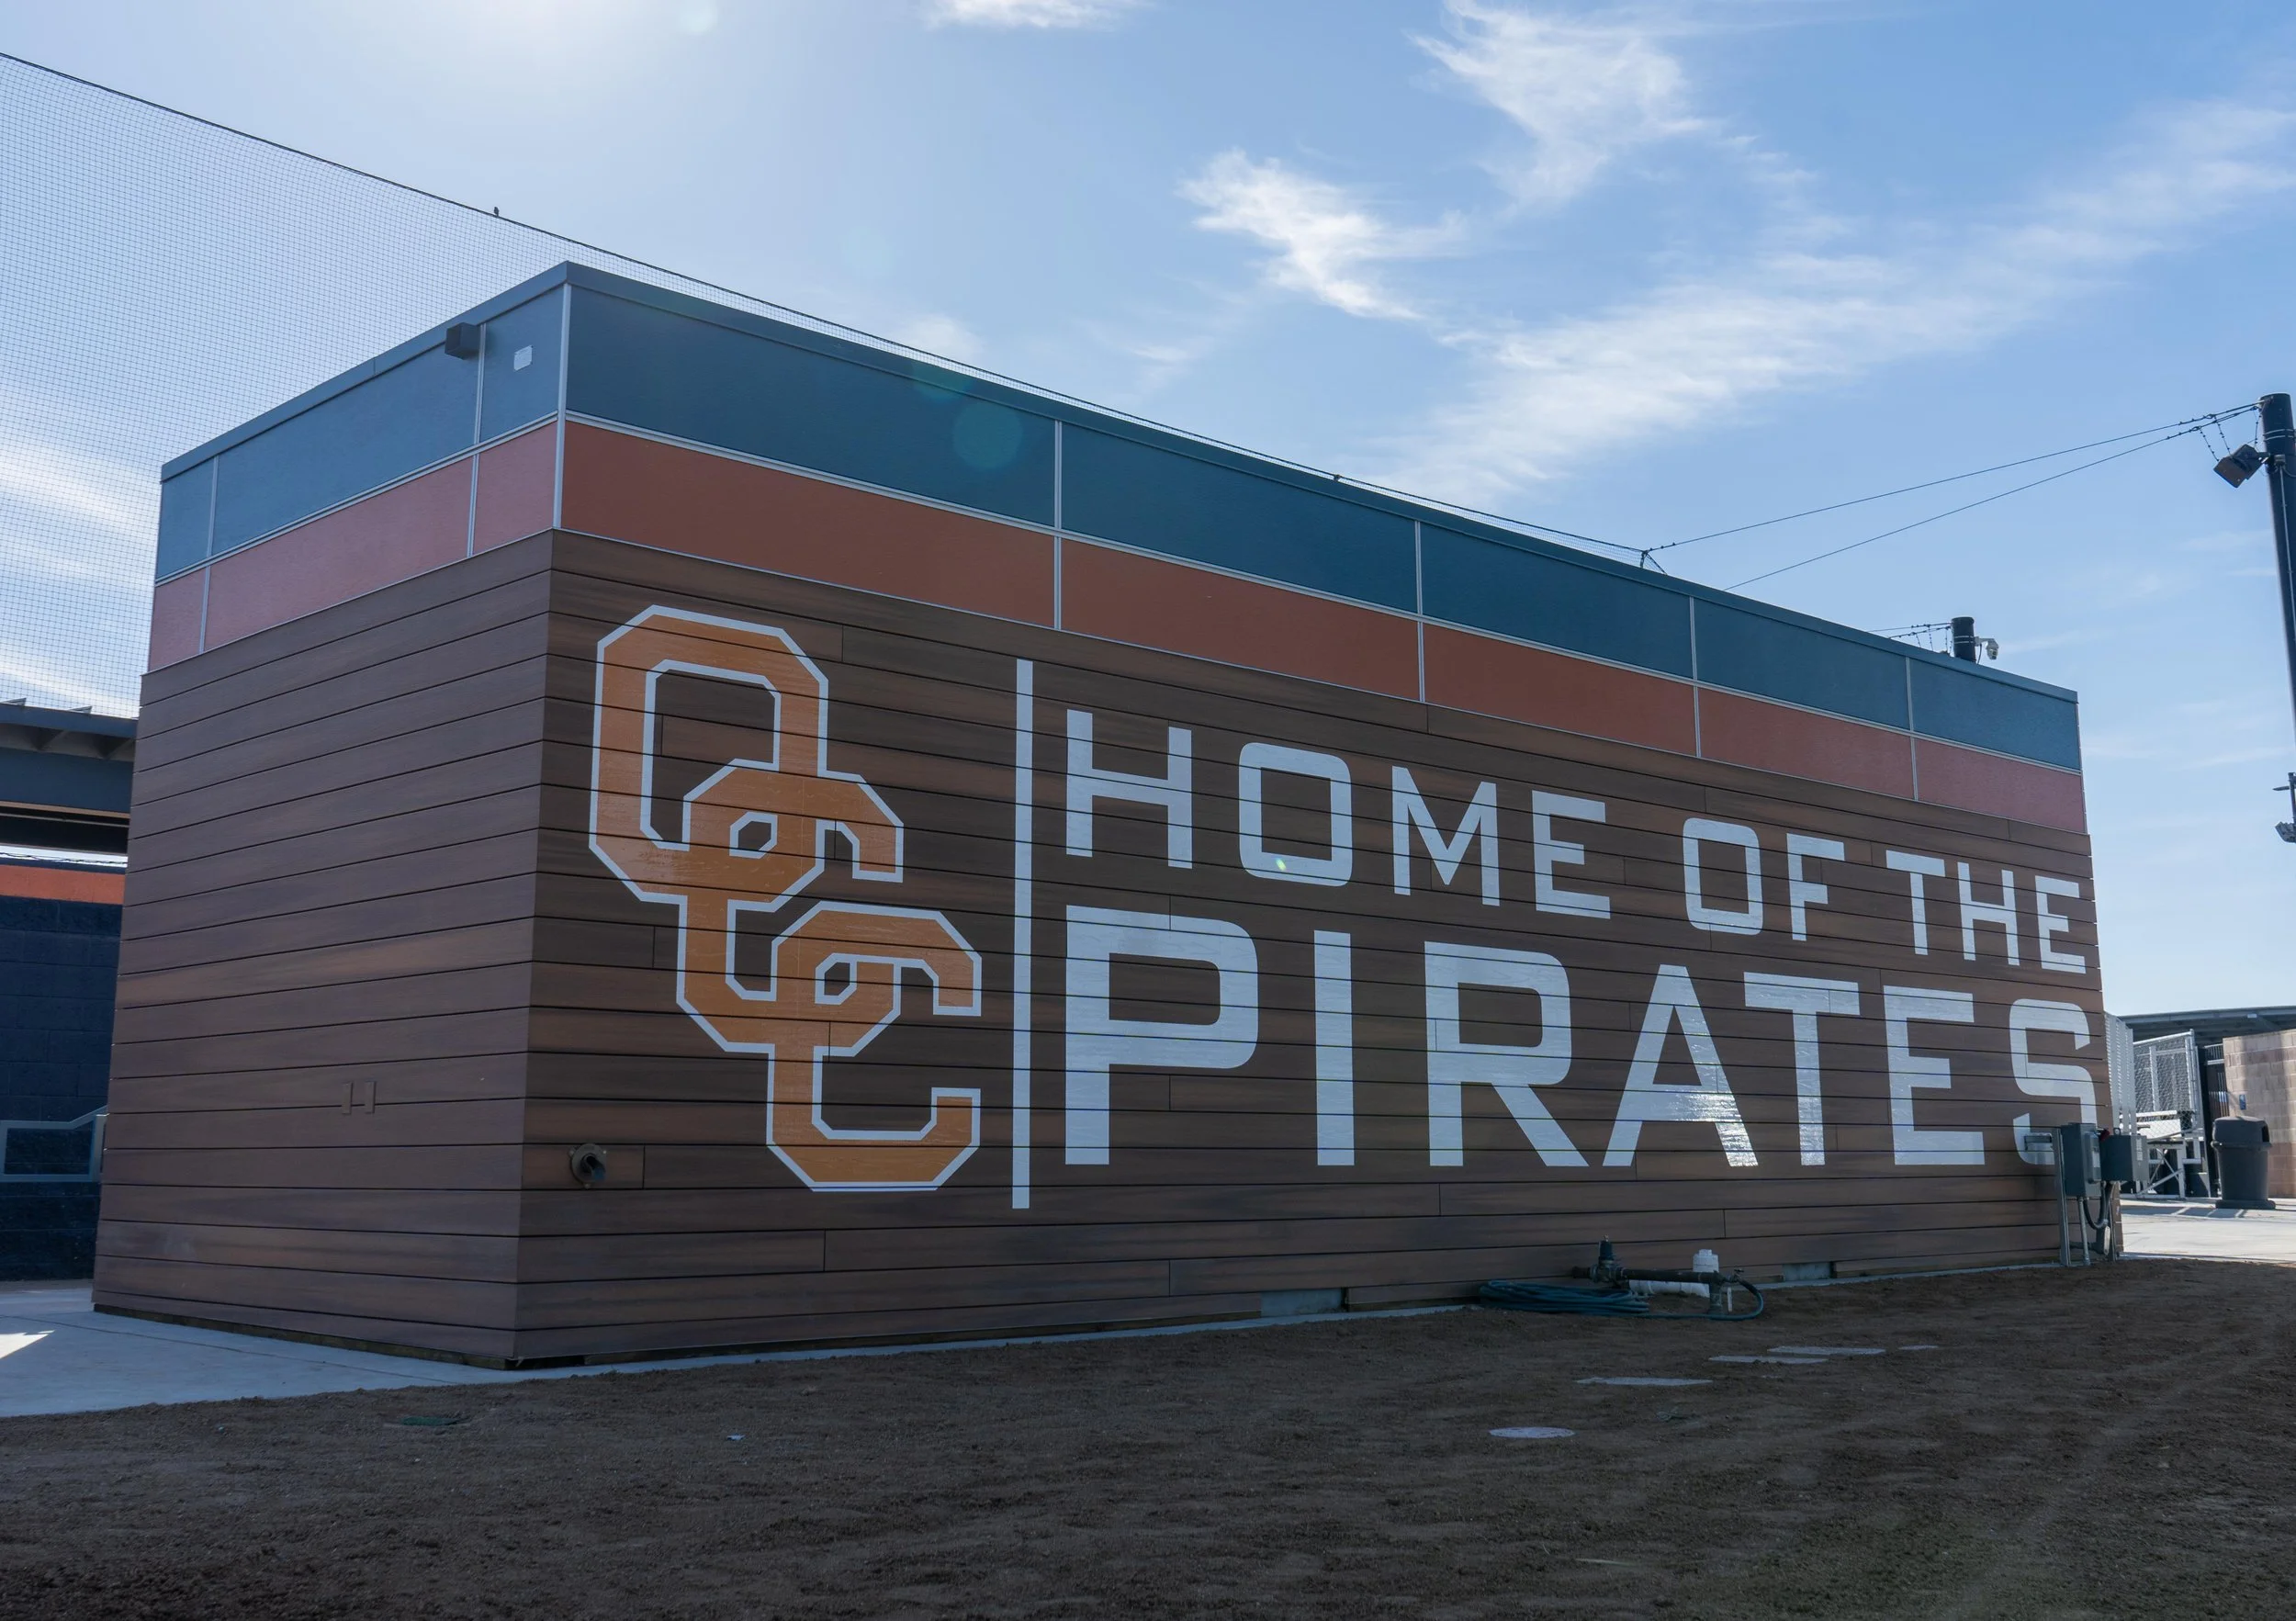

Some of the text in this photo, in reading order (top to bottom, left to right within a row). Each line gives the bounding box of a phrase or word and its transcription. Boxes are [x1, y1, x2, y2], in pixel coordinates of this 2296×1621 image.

[1066, 709, 2087, 974] HOME OF THE
[1064, 905, 2098, 1167] PIRATES
